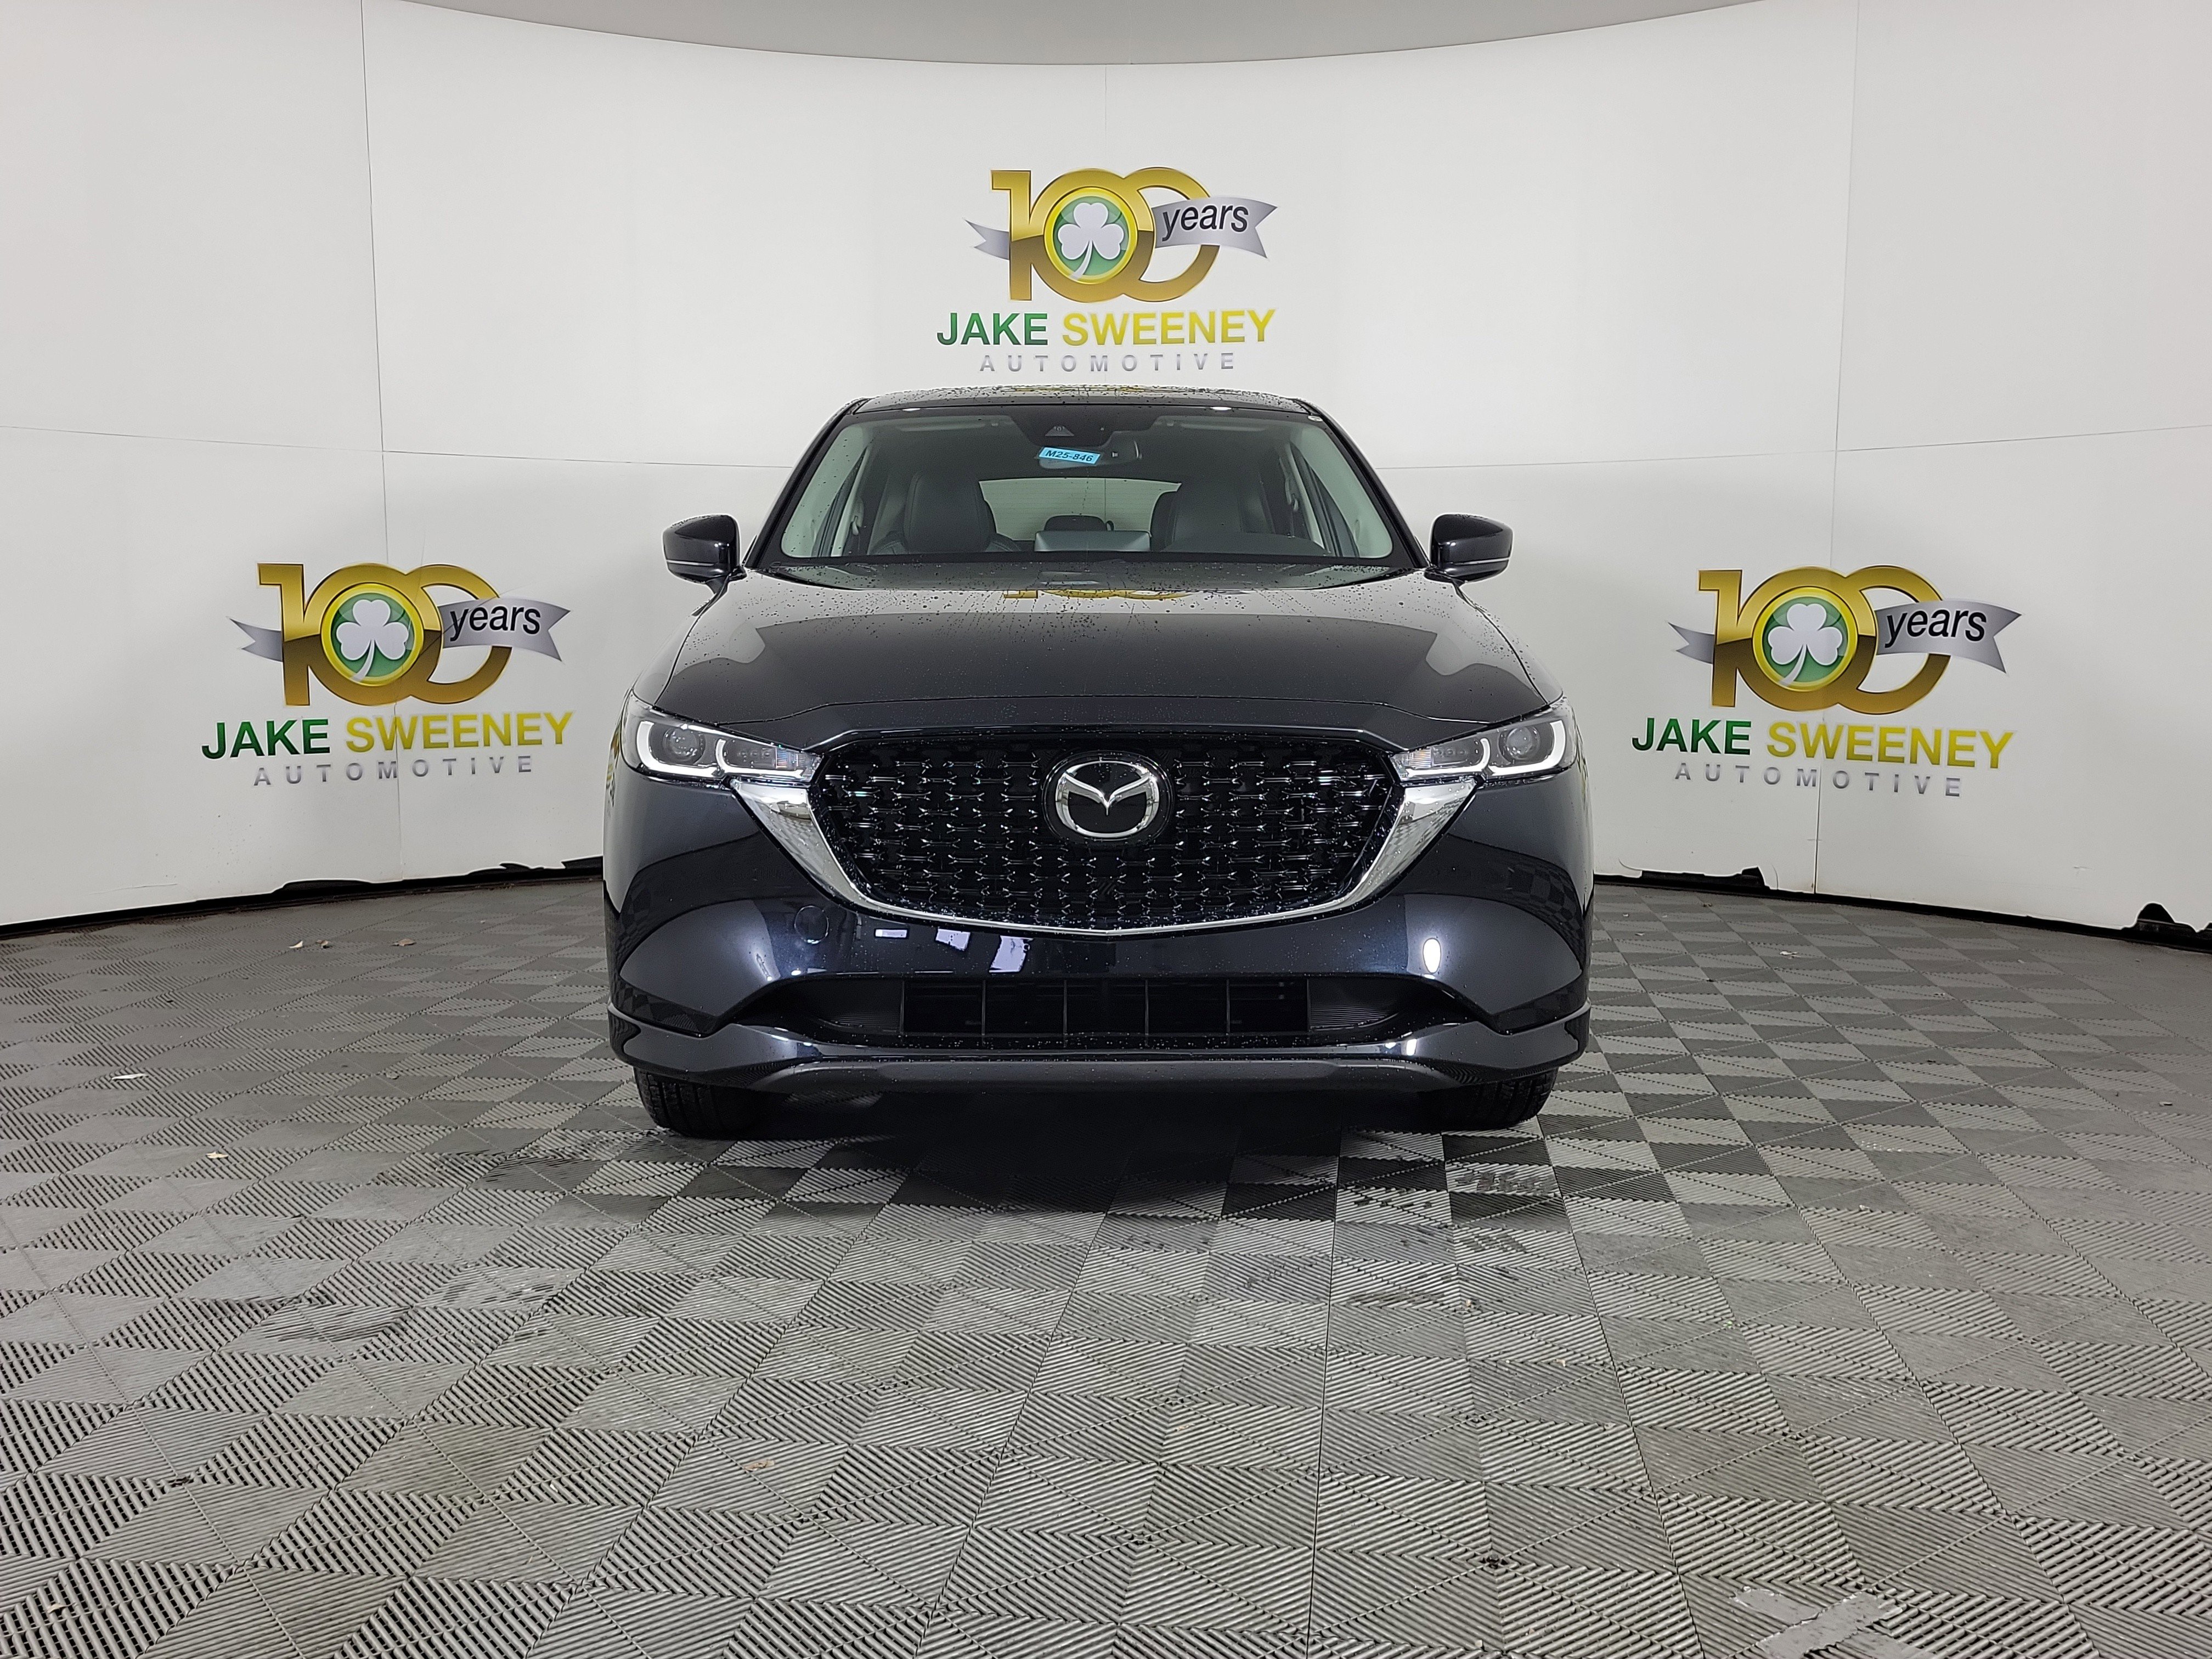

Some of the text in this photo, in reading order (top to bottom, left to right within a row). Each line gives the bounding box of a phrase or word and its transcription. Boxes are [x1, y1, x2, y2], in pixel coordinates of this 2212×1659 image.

[1161, 205, 1248, 241] years
[937, 309, 1276, 346] JAKE SWEENEY
[980, 353, 1234, 372] AUTOMOTIVE
[1046, 450, 1093, 461] M25-846
[450, 605, 540, 641] years
[1884, 607, 1986, 648] years
[202, 711, 574, 759] JAKE SWEENEY
[1632, 718, 2013, 769] JAKE SWEENEY
[253, 755, 532, 786] AUTOMOTIVE
[1675, 763, 1960, 797] AUTOMOTIVE
